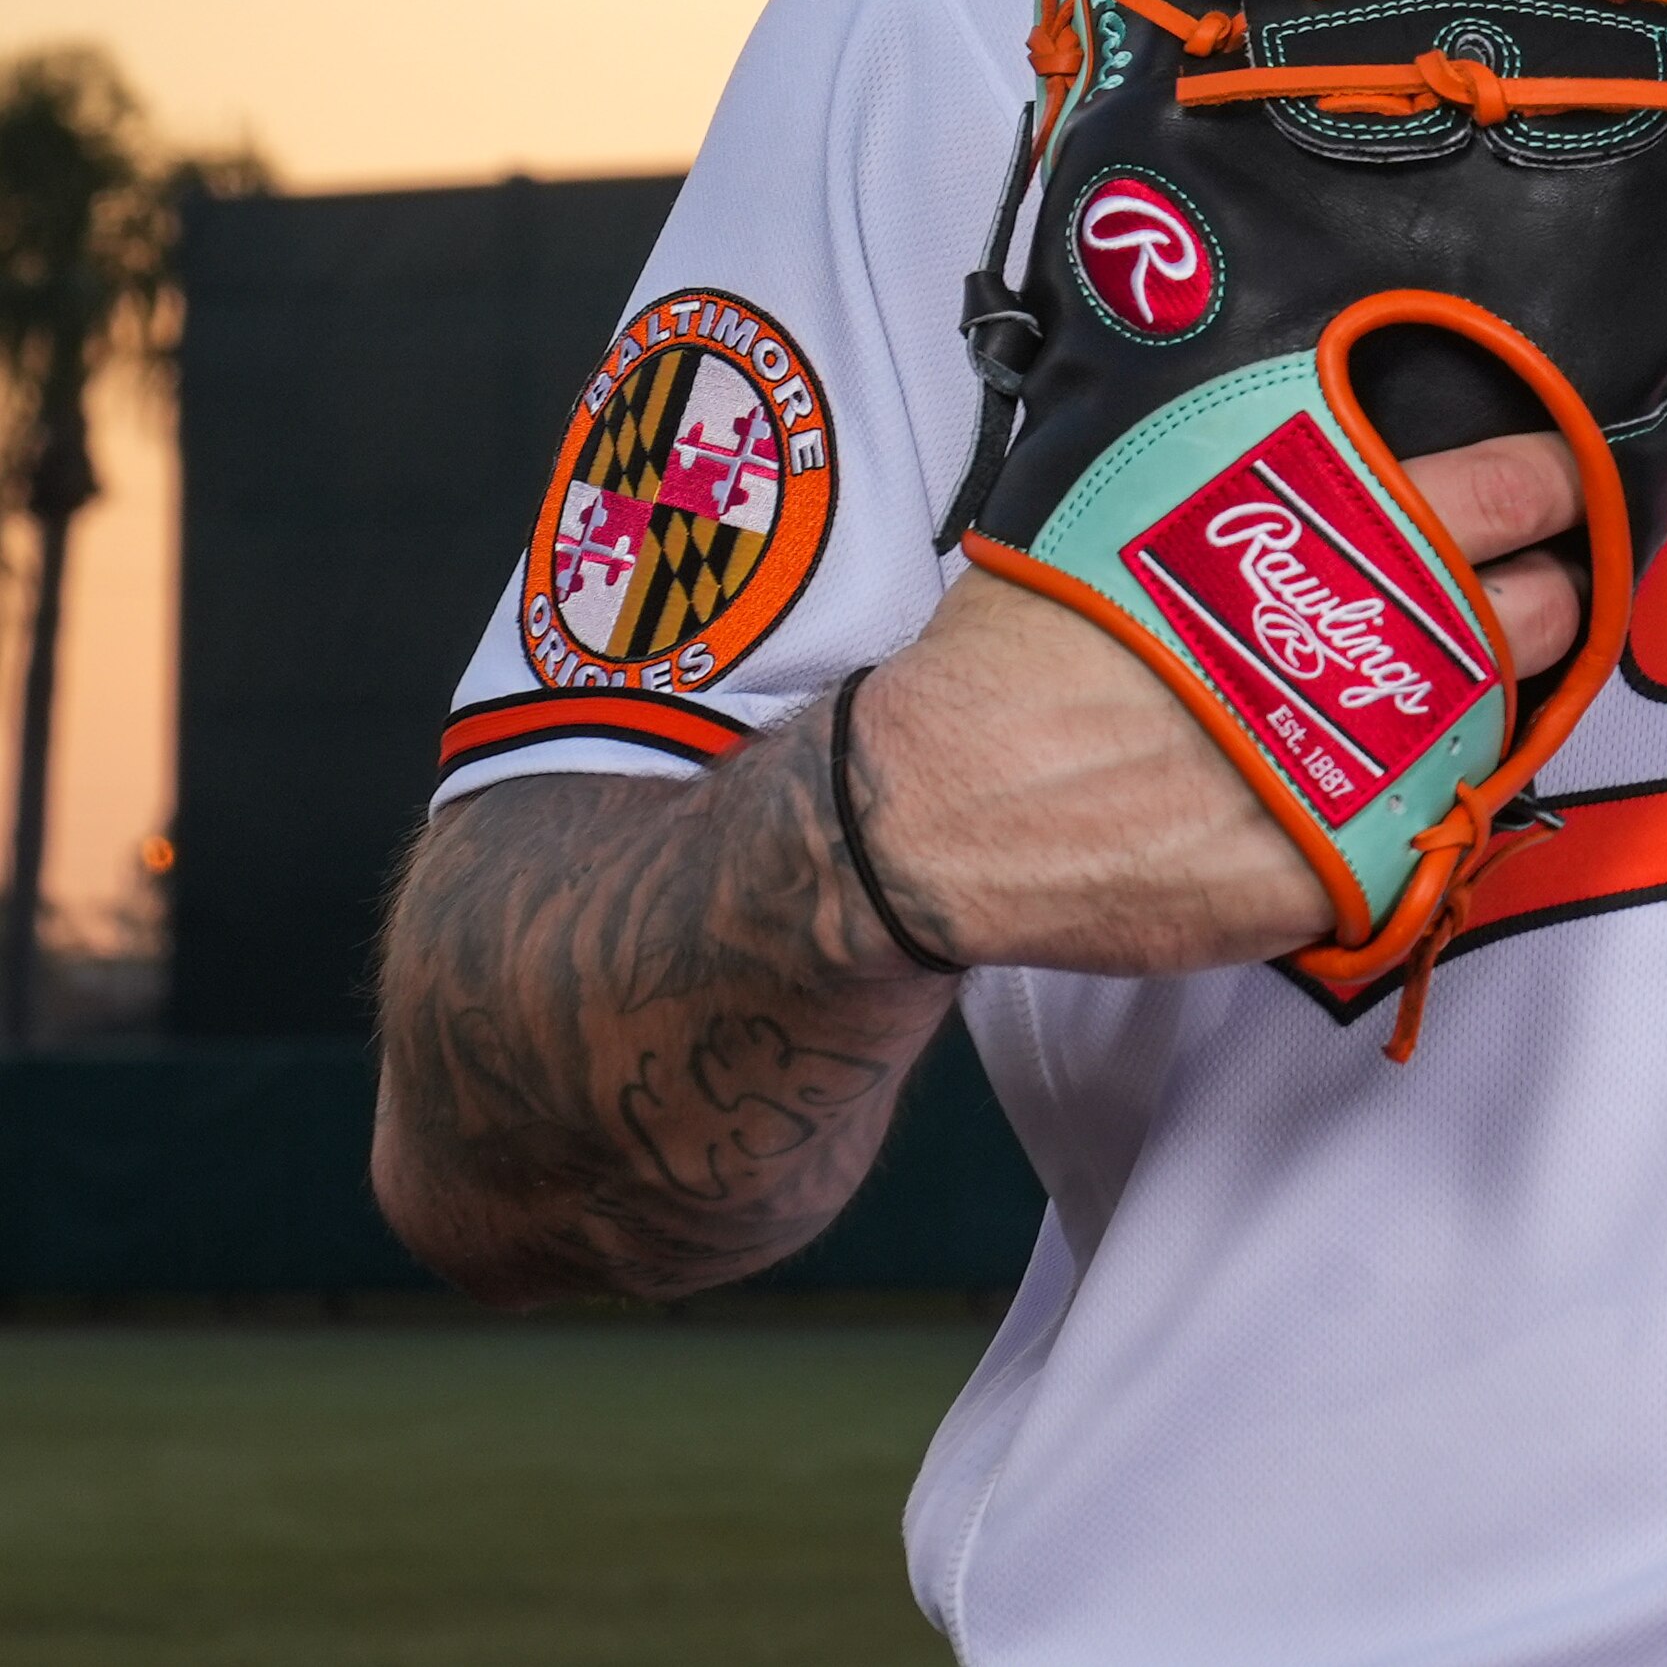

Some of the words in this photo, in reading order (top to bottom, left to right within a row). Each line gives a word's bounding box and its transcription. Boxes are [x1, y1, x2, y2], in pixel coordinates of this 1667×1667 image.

[1081, 195, 1197, 323] R
[585, 299, 825, 476] BALTIMORE
[1205, 501, 1432, 716] Rawlings
[1266, 704, 1308, 755] Est.
[1301, 746, 1355, 800] 1887
